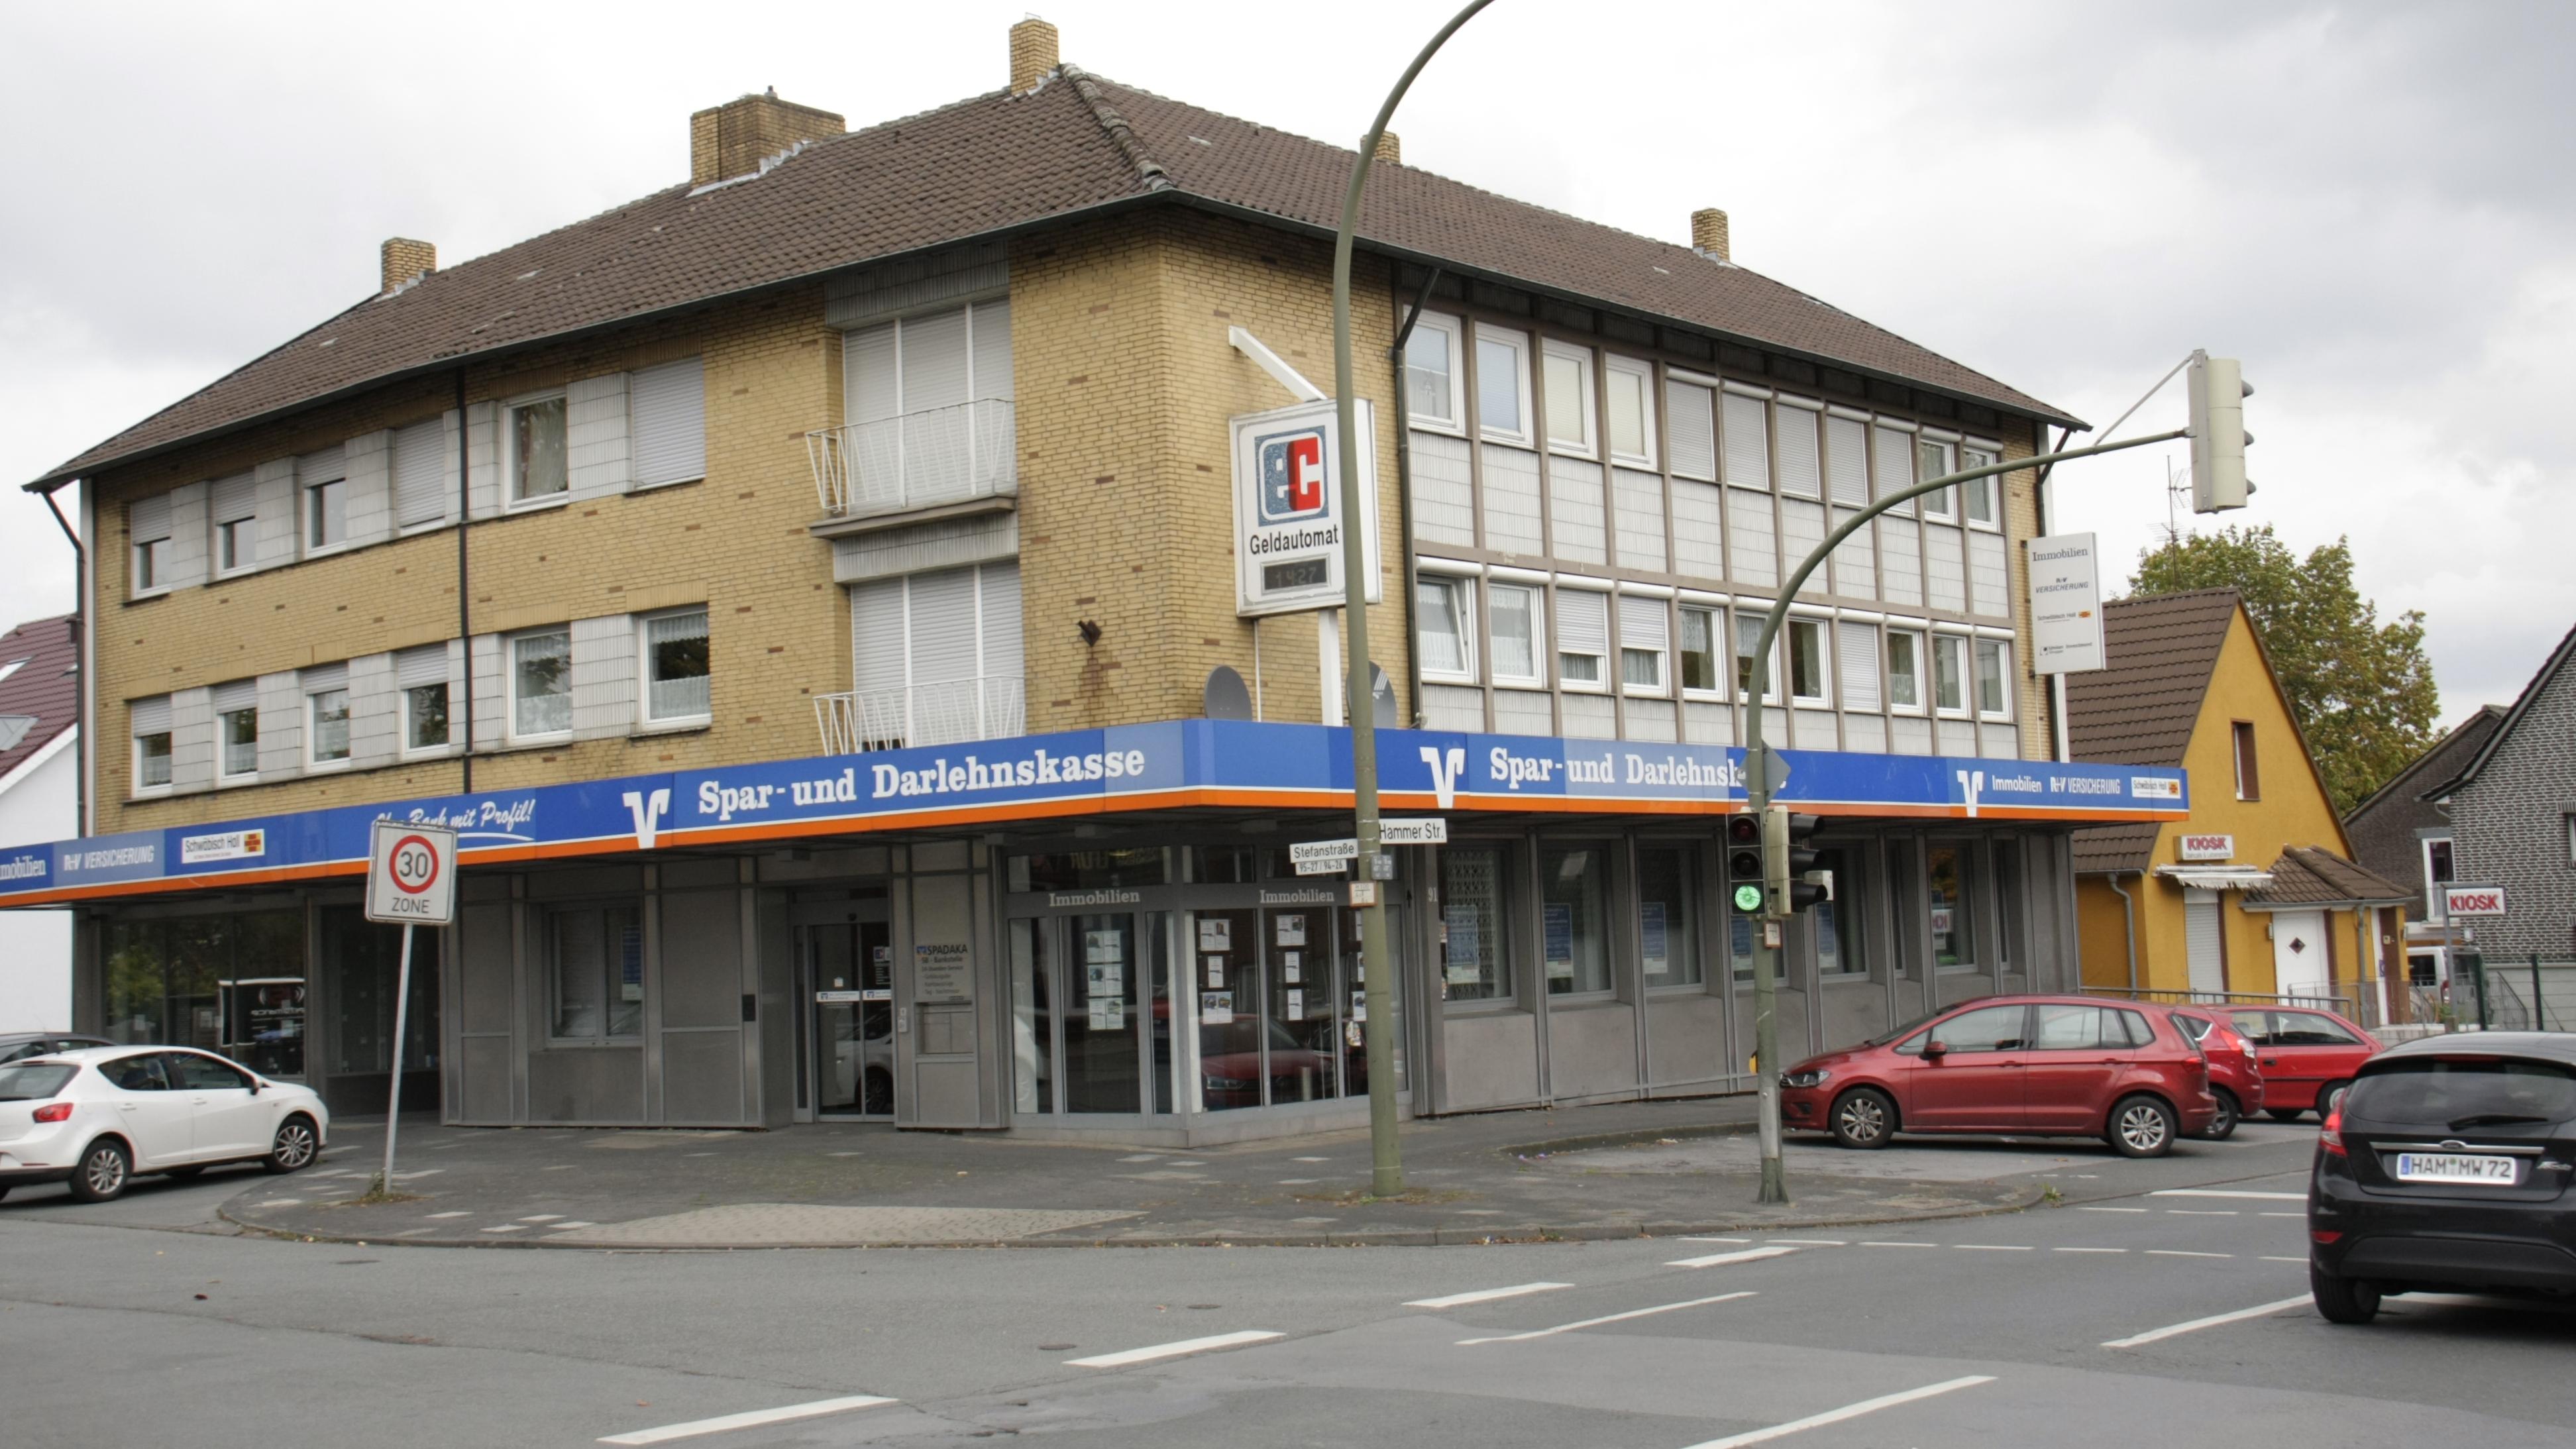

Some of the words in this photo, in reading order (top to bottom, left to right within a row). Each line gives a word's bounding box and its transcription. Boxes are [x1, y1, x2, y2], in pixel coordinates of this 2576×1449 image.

[1250, 524, 1339, 555] Geldautomat
[2032, 547, 2088, 562] Immobilien
[2035, 581, 2089, 594] VERSICHERUNG
[1490, 747, 1564, 789] Spar-
[1568, 753, 1615, 784] und
[1625, 753, 1787, 789] Darlehnsk
[698, 780, 786, 821] Spar-
[792, 768, 856, 806] und
[871, 749, 1145, 798] Darlehnskasse
[1992, 775, 2042, 793] Immobilien
[2068, 777, 2120, 794] VERSICHERUNG
[450, 808, 477, 828] mit
[480, 798, 536, 832] Profil!
[1379, 823, 1422, 840] Hammer
[1425, 822, 1444, 839] Str.
[186, 837, 225, 853] Schwäbisch
[227, 834, 241, 849] Hall
[1294, 843, 1354, 859] Stefanstraße
[2187, 837, 2227, 851] KIOSK
[84, 845, 155, 870] VERSICHERUNG
[398, 851, 429, 879] 30
[1049, 890, 1141, 907] Immobilien
[1260, 889, 1335, 904] Immobilien
[1428, 887, 1438, 902] 91
[2449, 894, 2500, 911] KIOSK
[392, 896, 430, 914] ZONE
[927, 944, 968, 955] SPADAKA
[2411, 1157, 2446, 1174] HAM
[2459, 1159, 2484, 1176] MW
[2488, 1161, 2512, 1178] 72
